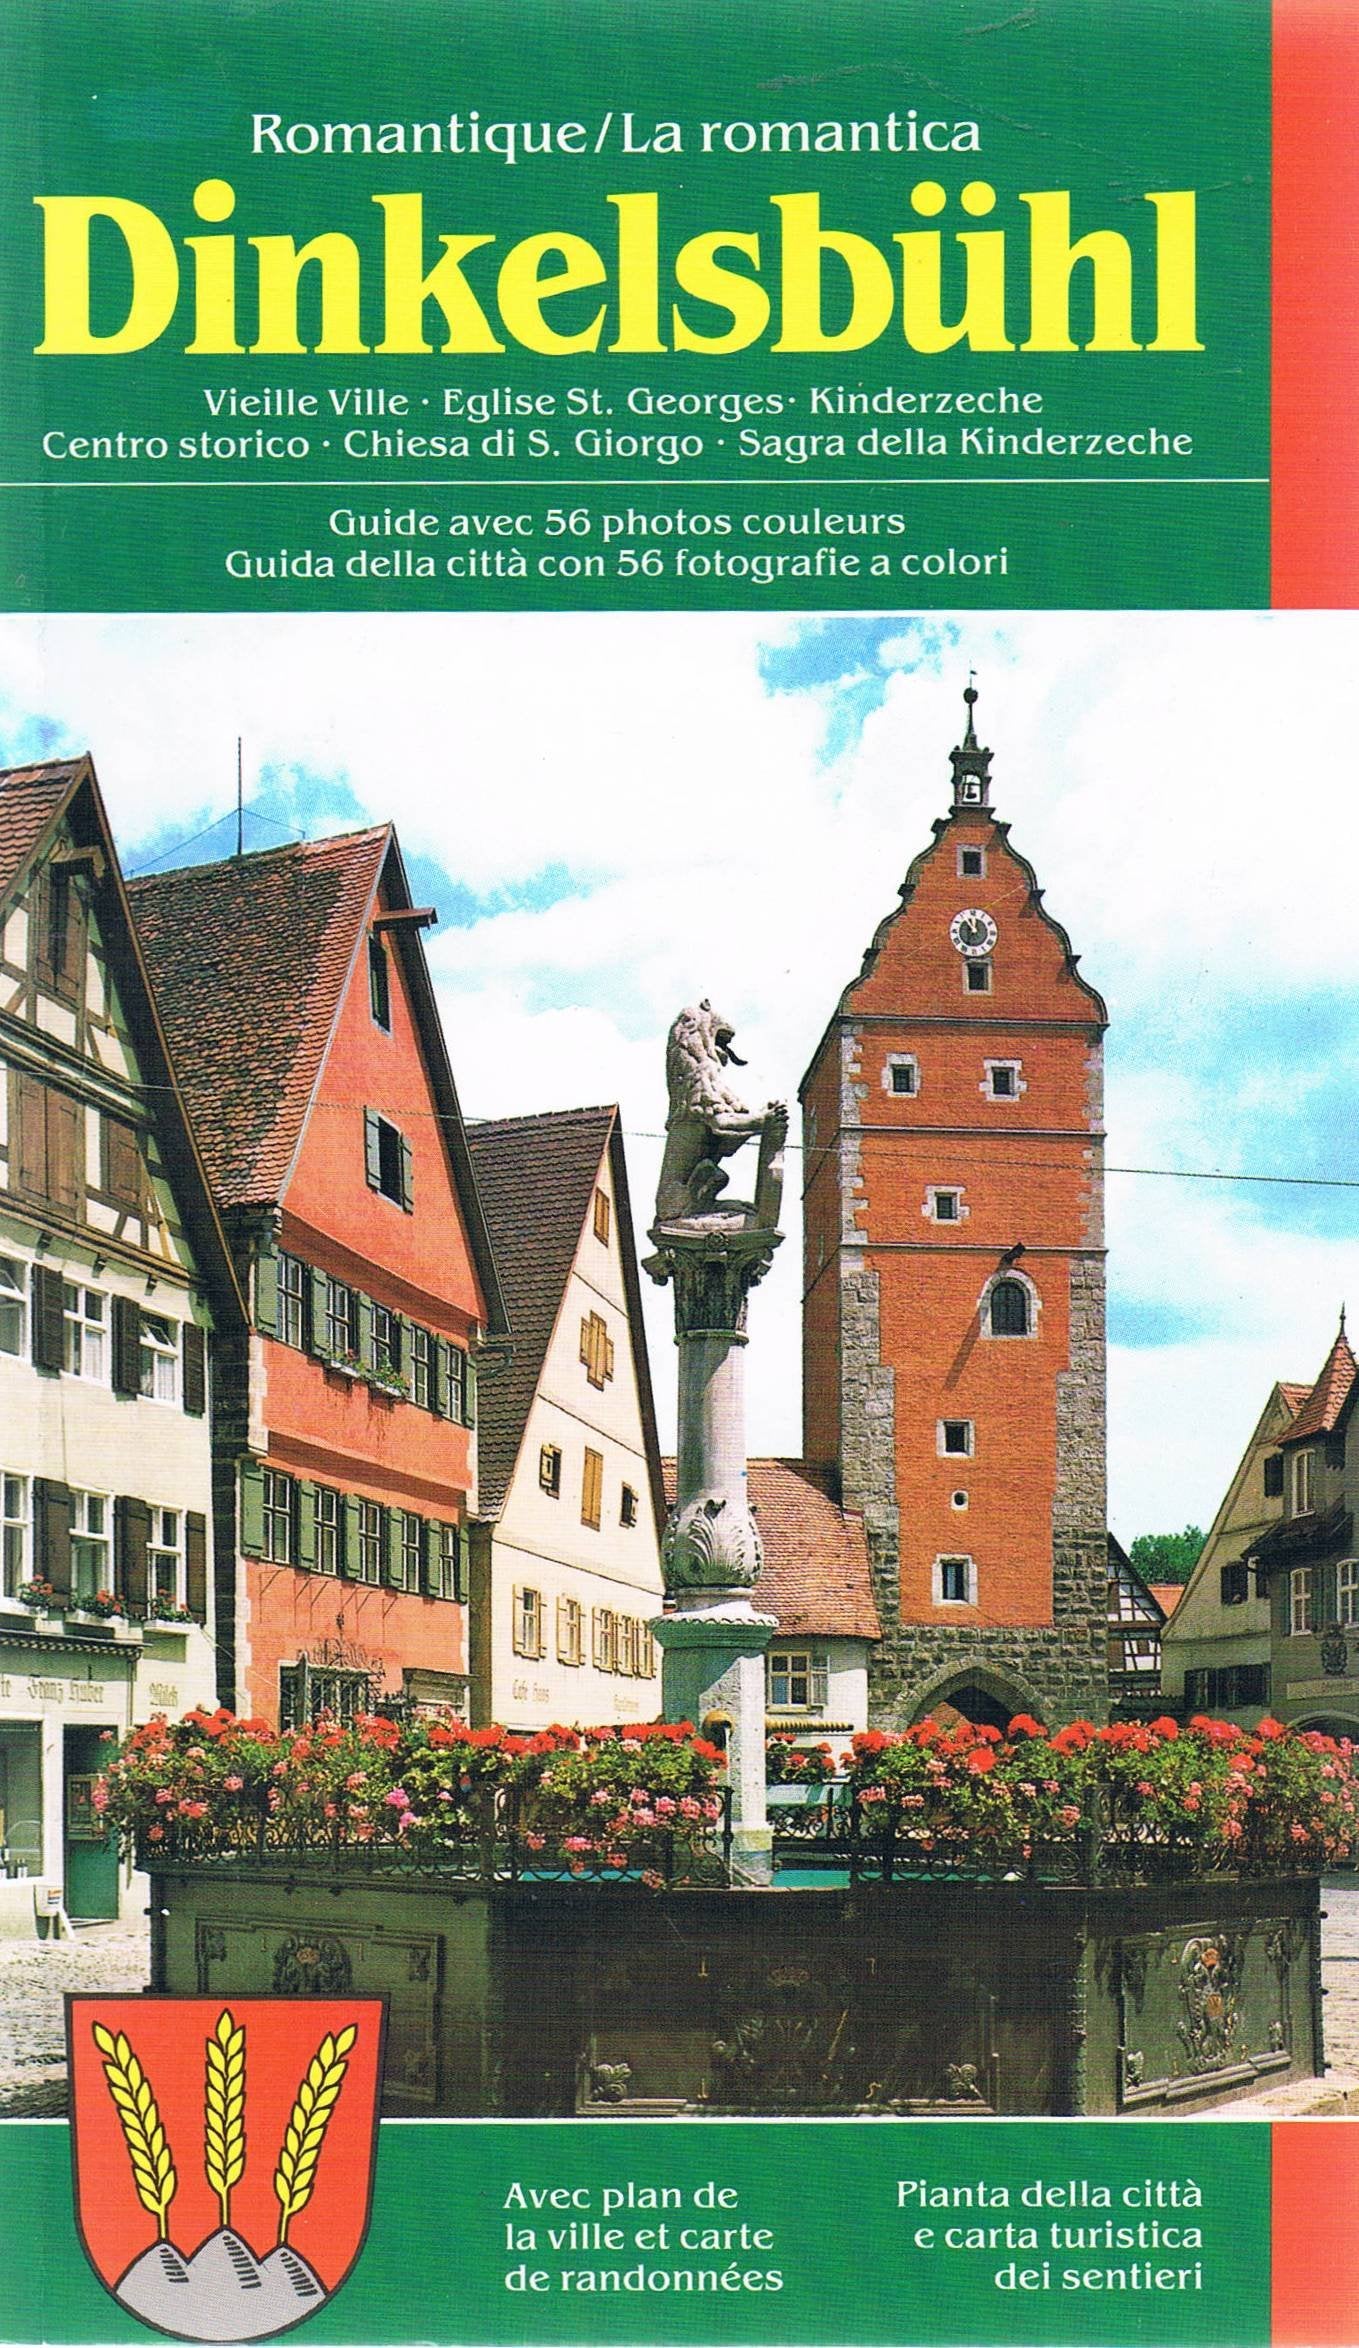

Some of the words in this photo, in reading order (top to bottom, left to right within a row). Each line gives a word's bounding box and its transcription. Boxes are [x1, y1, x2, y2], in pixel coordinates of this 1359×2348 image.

[701, 110, 981, 152] romantica
[33, 179, 1205, 355] Dinkelsbühl
[204, 388, 317, 416] Vieille
[329, 388, 408, 415] Ville
[444, 387, 555, 423] Eglise
[568, 388, 612, 415] St.
[812, 386, 1042, 413] Kinderzeche
[43, 432, 168, 458] Centro
[180, 430, 309, 458] storico
[345, 429, 468, 457] Chiesa
[482, 429, 514, 456] di
[529, 430, 559, 456] S.
[576, 429, 703, 464] Giorgo
[740, 429, 845, 463] Sagra
[858, 428, 946, 455] della
[962, 427, 1192, 455] Kinderzeche
[330, 509, 438, 535] Guide
[450, 516, 532, 535] avec
[545, 509, 590, 535] 56
[603, 509, 731, 542] photos
[743, 508, 905, 534] couleurs
[226, 550, 334, 577] Guida
[346, 550, 435, 576] della
[447, 548, 527, 576] città
[539, 556, 604, 576] con
[618, 550, 663, 576] 56
[676, 548, 859, 583] fotografie
[871, 555, 890, 575] a
[902, 548, 1007, 575] colori
[504, 2183, 589, 2208] Avec
[603, 2182, 681, 2216] plan
[694, 2182, 737, 2208] de
[898, 2180, 1009, 2207] Pianta
[1022, 2181, 1111, 2207] della
[1123, 2179, 1201, 2207] città
[507, 2223, 536, 2250] la
[548, 2223, 624, 2249] ville
[635, 2224, 669, 2249] et
[681, 2224, 772, 2249] carte
[915, 2229, 933, 2248] e
[945, 2223, 1038, 2248] carta
[1051, 2221, 1202, 2248] turistica
[505, 2265, 549, 2291] de
[562, 2262, 783, 2291] randonnées
[995, 2262, 1049, 2289] dei
[1063, 2262, 1201, 2289] sentieri
